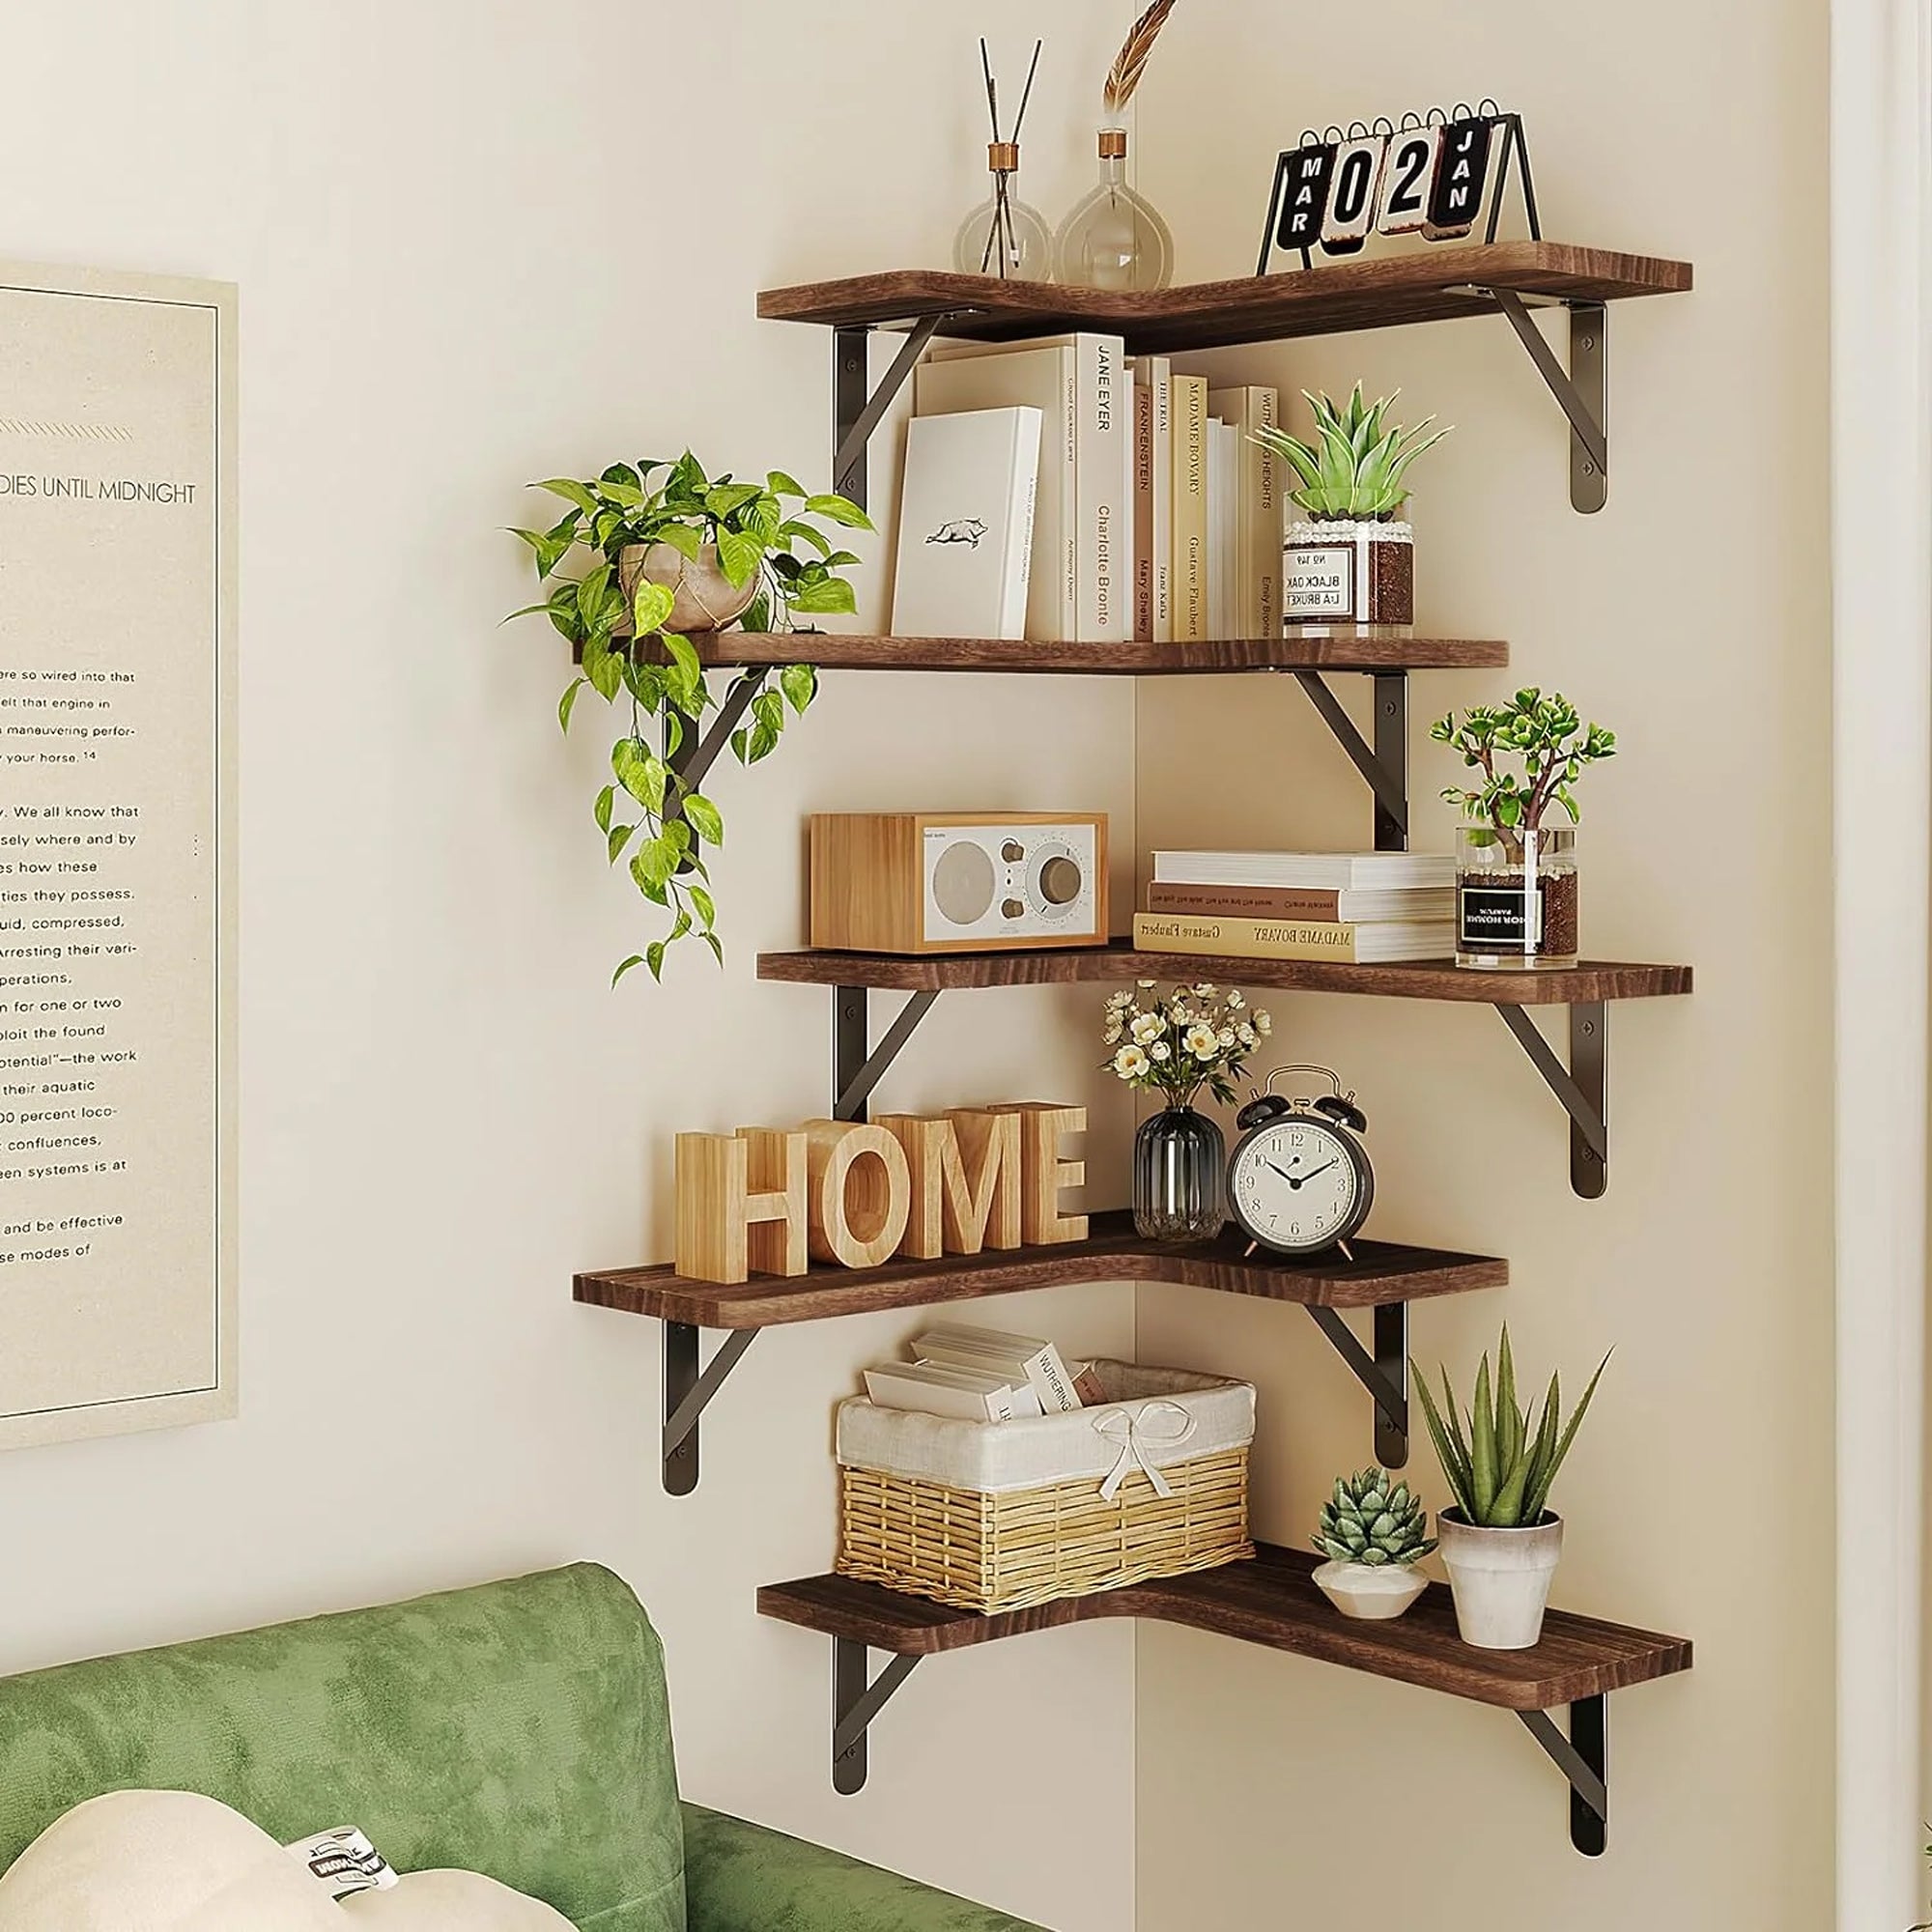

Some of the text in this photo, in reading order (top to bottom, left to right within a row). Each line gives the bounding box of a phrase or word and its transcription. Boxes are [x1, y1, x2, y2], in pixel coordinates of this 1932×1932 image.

[1449, 130, 1473, 209] JAN
[1292, 156, 1322, 233] MAR
[1098, 346, 1110, 430] JANE EYER
[1140, 393, 1149, 490] FRANKENSTEIN
[1190, 384, 1199, 495] MADAME BOVARY
[0, 475, 195, 503] DIES UNTIL MIDNIGHT
[1263, 462, 1271, 508] HEIGHTS
[1098, 506, 1110, 625] Charlotte Bronte
[1190, 537, 1199, 636] Gustave Flaubert
[1261, 577, 1271, 603] Emily
[1138, 560, 1150, 636] Mary Shelley
[42, 670, 76, 681] wired
[111, 672, 134, 682] that
[23, 698, 46, 707] that
[52, 700, 94, 710] engine
[8, 727, 88, 738] maneuvering
[93, 726, 134, 737] perfor-
[7, 754, 35, 763] your
[41, 753, 78, 762] horse.
[14, 807, 38, 817] We
[43, 807, 59, 817] all
[66, 807, 105, 817] know
[111, 807, 138, 817] that
[1, 834, 135, 846] sely where and by
[19, 862, 51, 873] how
[58, 863, 97, 872] these
[34, 890, 65, 902] they
[71, 891, 134, 901] possess.
[32, 916, 124, 929] compressed,
[68, 944, 99, 955] their
[105, 943, 136, 953] vari-
[0, 975, 71, 987] perations,
[14, 1002, 34, 1011] for
[40, 1002, 67, 1011] one
[72, 1001, 87, 1009] or
[94, 1000, 121, 1009] two
[35, 1028, 56, 1038] the
[63, 1025, 104, 1037] found
[100, 1051, 136, 1062] work
[3, 1080, 95, 1095] their aquatic
[20, 1110, 75, 1123] percent
[82, 1107, 117, 1118] loco-
[9, 1136, 100, 1151] confluences,
[1271, 1139, 1282, 1151] 11
[1291, 1133, 1303, 1147] 12
[1255, 1153, 1266, 1168] 10
[28, 1164, 89, 1179] systems
[96, 1161, 106, 1171] is
[113, 1161, 126, 1170] at
[1246, 1176, 1255, 1189] 9
[1338, 1179, 1346, 1192] 3
[674, 1101, 1089, 1285] HOME
[1252, 1199, 1261, 1211] 8
[4, 1215, 123, 1235] and be effective
[1269, 1214, 1278, 1228] 7
[1315, 1216, 1323, 1230] 5
[1291, 1222, 1300, 1236] 6
[21, 1248, 69, 1260] modes
[75, 1244, 90, 1256] of
[1038, 1353, 1071, 1411] WUTHERING
